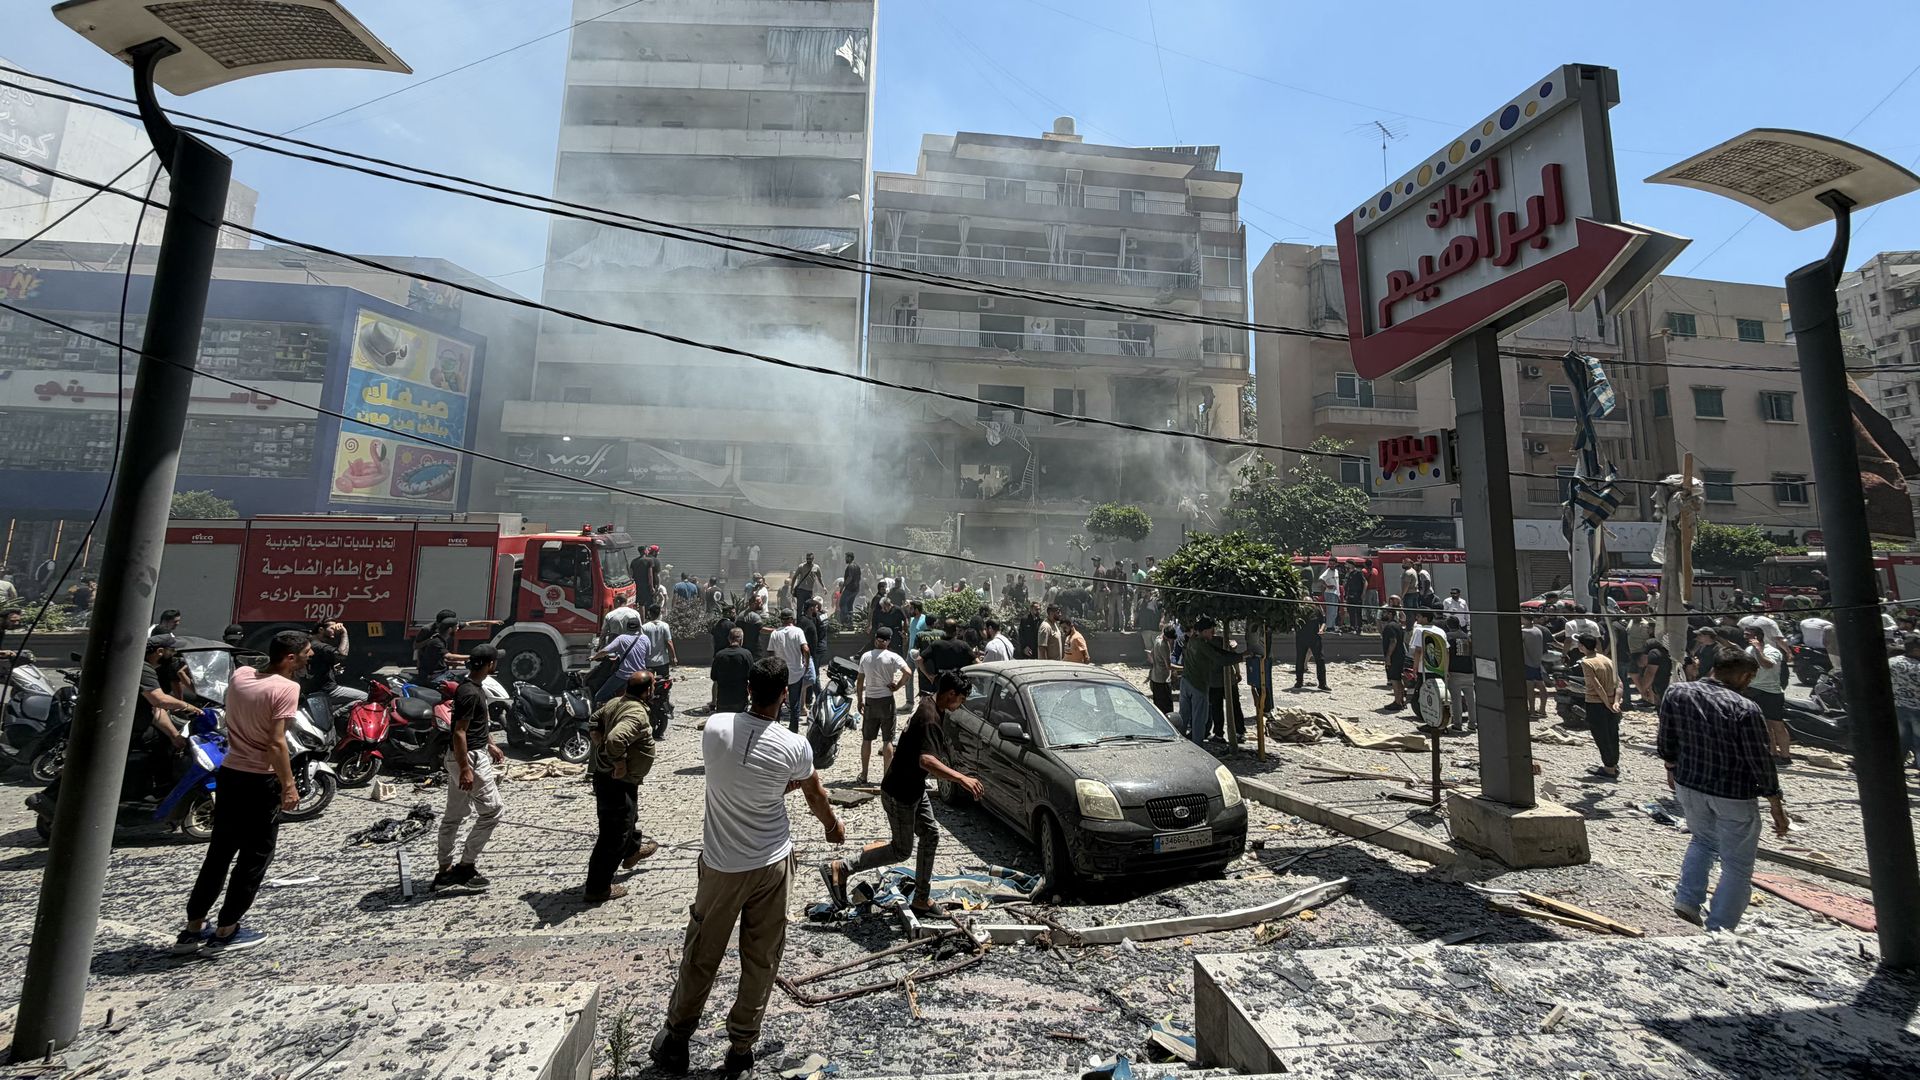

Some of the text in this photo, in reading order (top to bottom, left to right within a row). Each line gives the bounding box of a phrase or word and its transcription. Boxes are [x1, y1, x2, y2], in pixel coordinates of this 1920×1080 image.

[1378, 163, 1566, 329] ابراهيم
[265, 534, 305, 552] الجنوبية
[306, 534, 343, 551] الضاحية
[343, 535, 374, 551] بلديات
[262, 557, 394, 581] فوج إطفاء الضاحية
[340, 584, 391, 603] مركز
[303, 603, 334, 621] 1290
